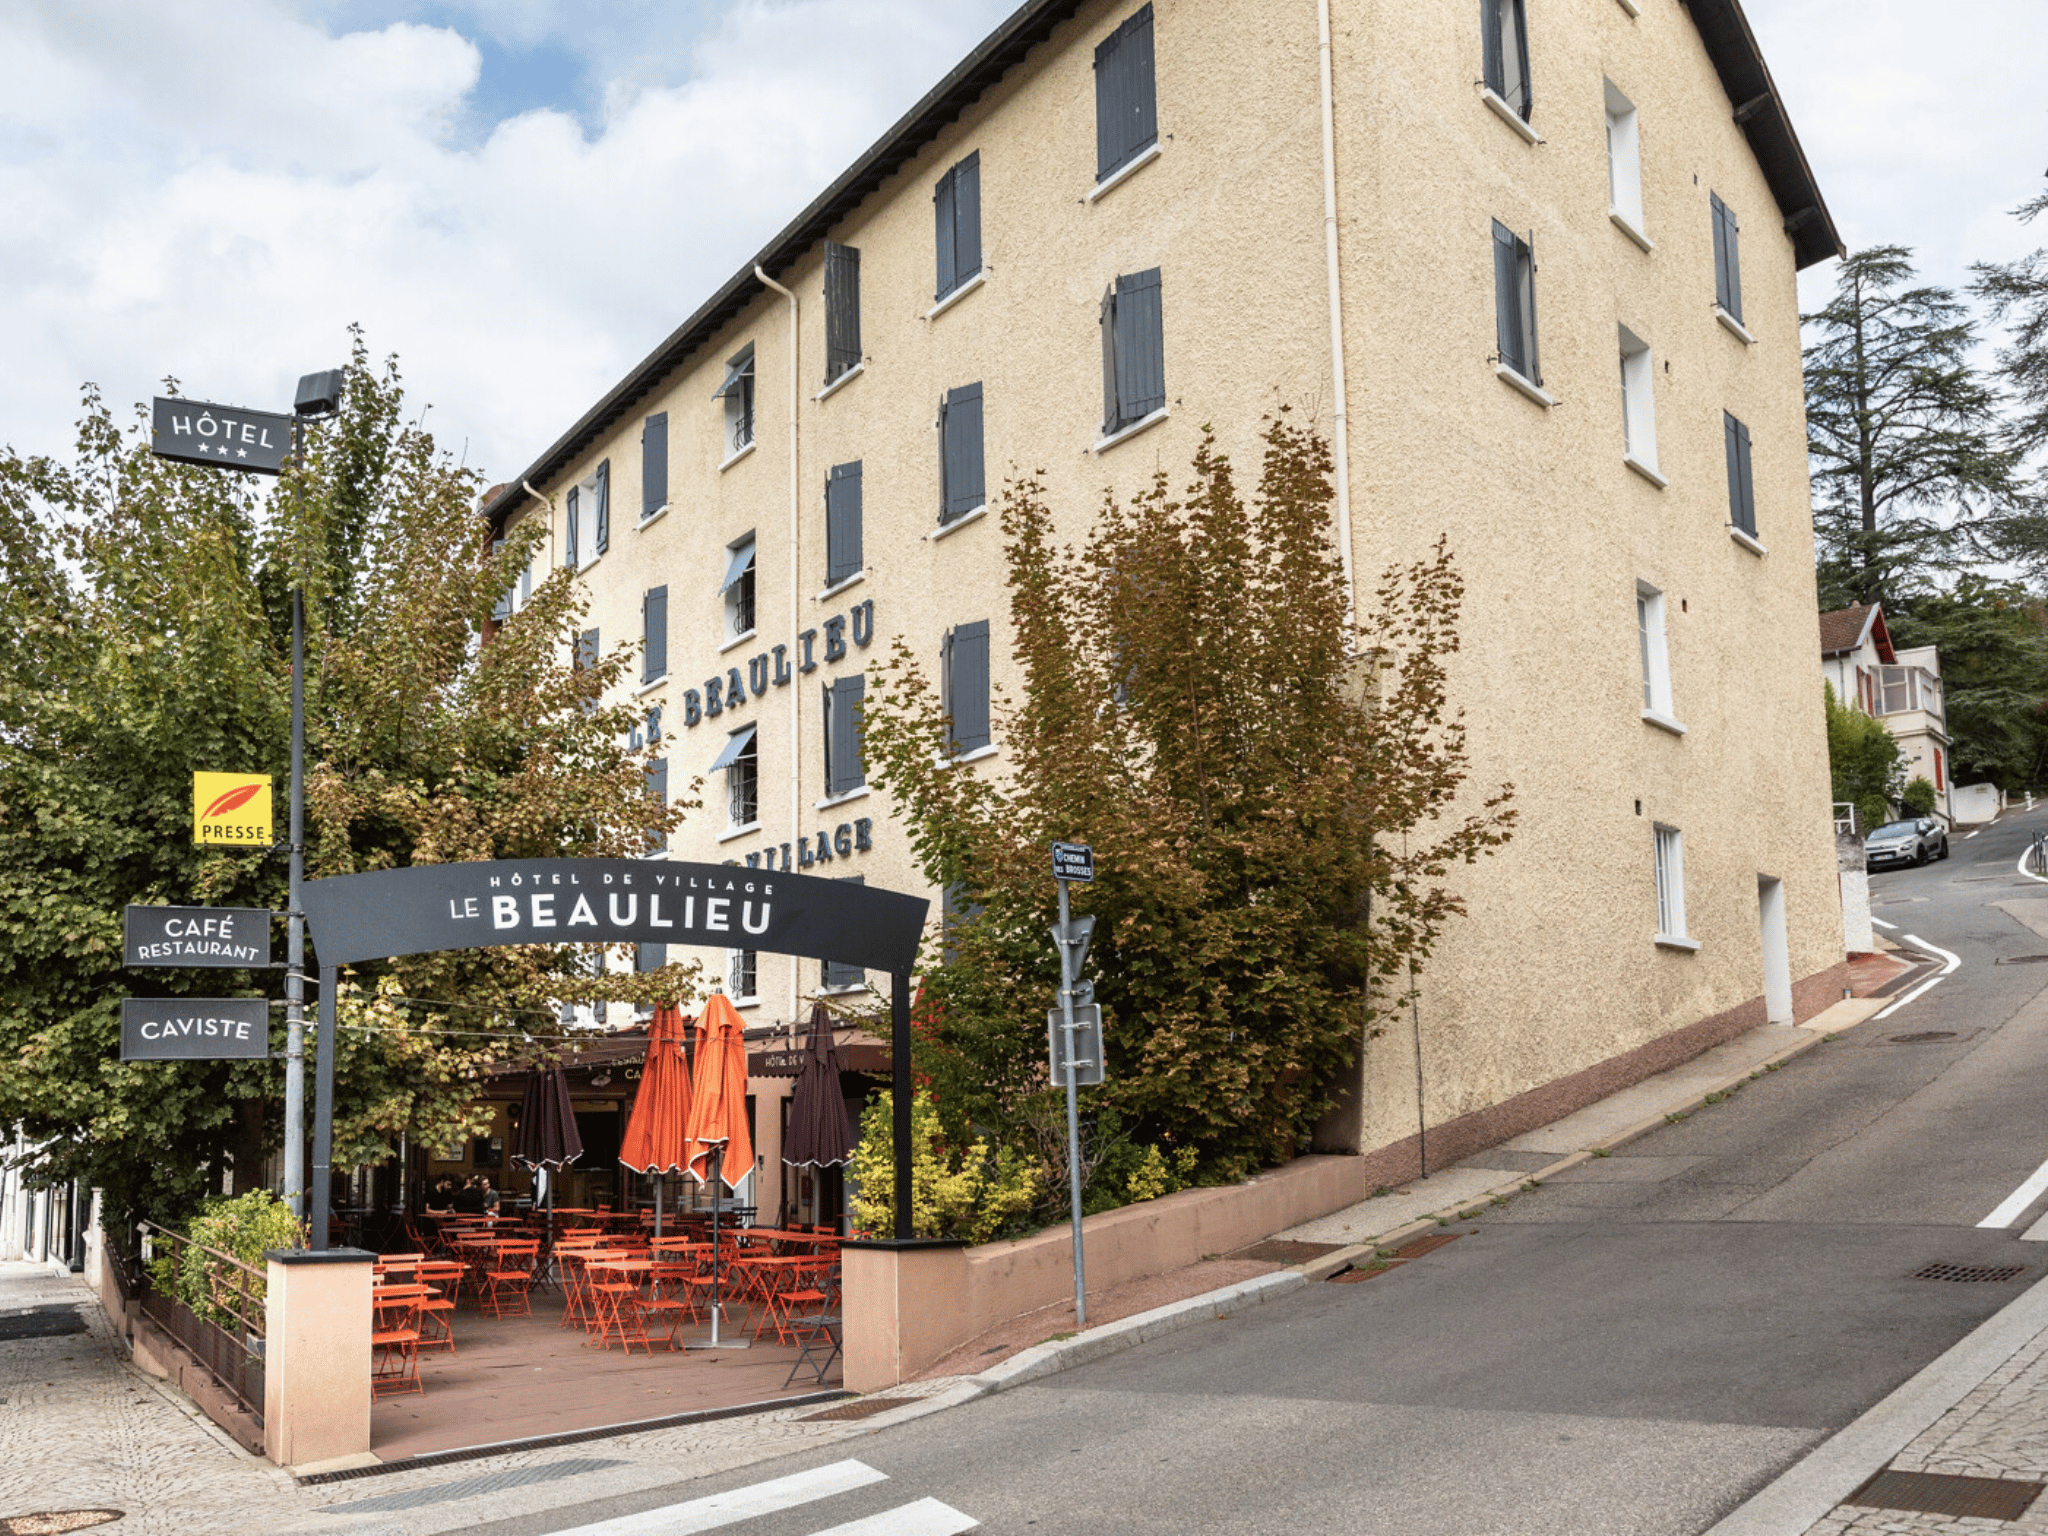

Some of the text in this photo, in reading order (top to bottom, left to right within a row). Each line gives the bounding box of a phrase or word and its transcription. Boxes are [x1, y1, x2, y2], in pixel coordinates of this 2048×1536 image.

[172, 411, 274, 449] HÔTEL
[683, 599, 874, 727] BEAULIEU
[203, 825, 264, 840] PRESSE
[1063, 853, 1085, 864] CHEMIN
[491, 872, 773, 895] HÔTEL DE VILLAGE
[450, 892, 771, 934] LE BEAULIEU
[165, 915, 234, 939] CAFÉ
[138, 941, 259, 962] RESTAURANT
[140, 1018, 251, 1040] CAVISTE
